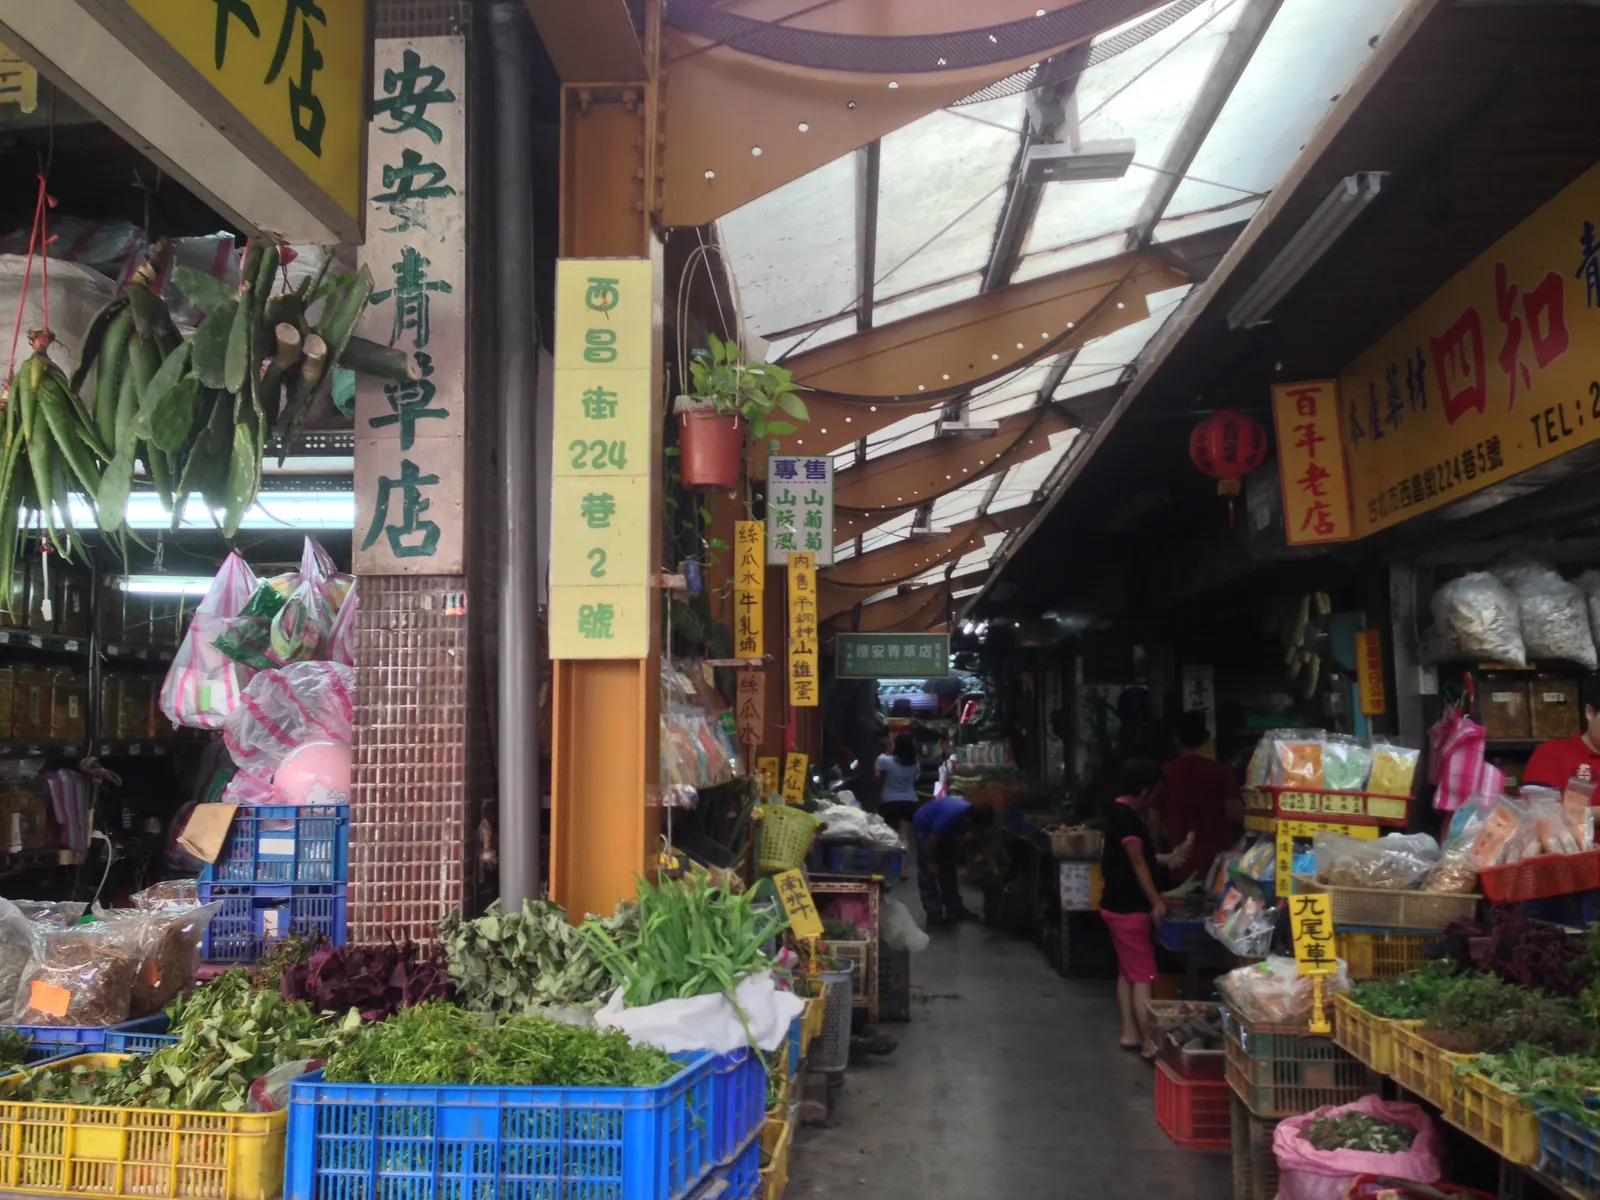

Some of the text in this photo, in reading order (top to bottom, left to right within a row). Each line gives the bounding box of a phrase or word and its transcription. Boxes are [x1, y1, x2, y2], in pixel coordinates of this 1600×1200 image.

[213, 0, 327, 159] 店
[360, 48, 456, 558] 安安青草店
[1430, 261, 1570, 427] 四知
[567, 276, 628, 641] 西昌街224巷2號
[774, 459, 827, 480] 專售
[1285, 386, 1335, 536] 百年老店
[775, 488, 797, 551] 山防風
[803, 488, 825, 552] 山葡萄
[855, 643, 932, 659] 德安青草店
[739, 676, 761, 742] 絲瓜水
[1295, 895, 1335, 971] 九尾草
